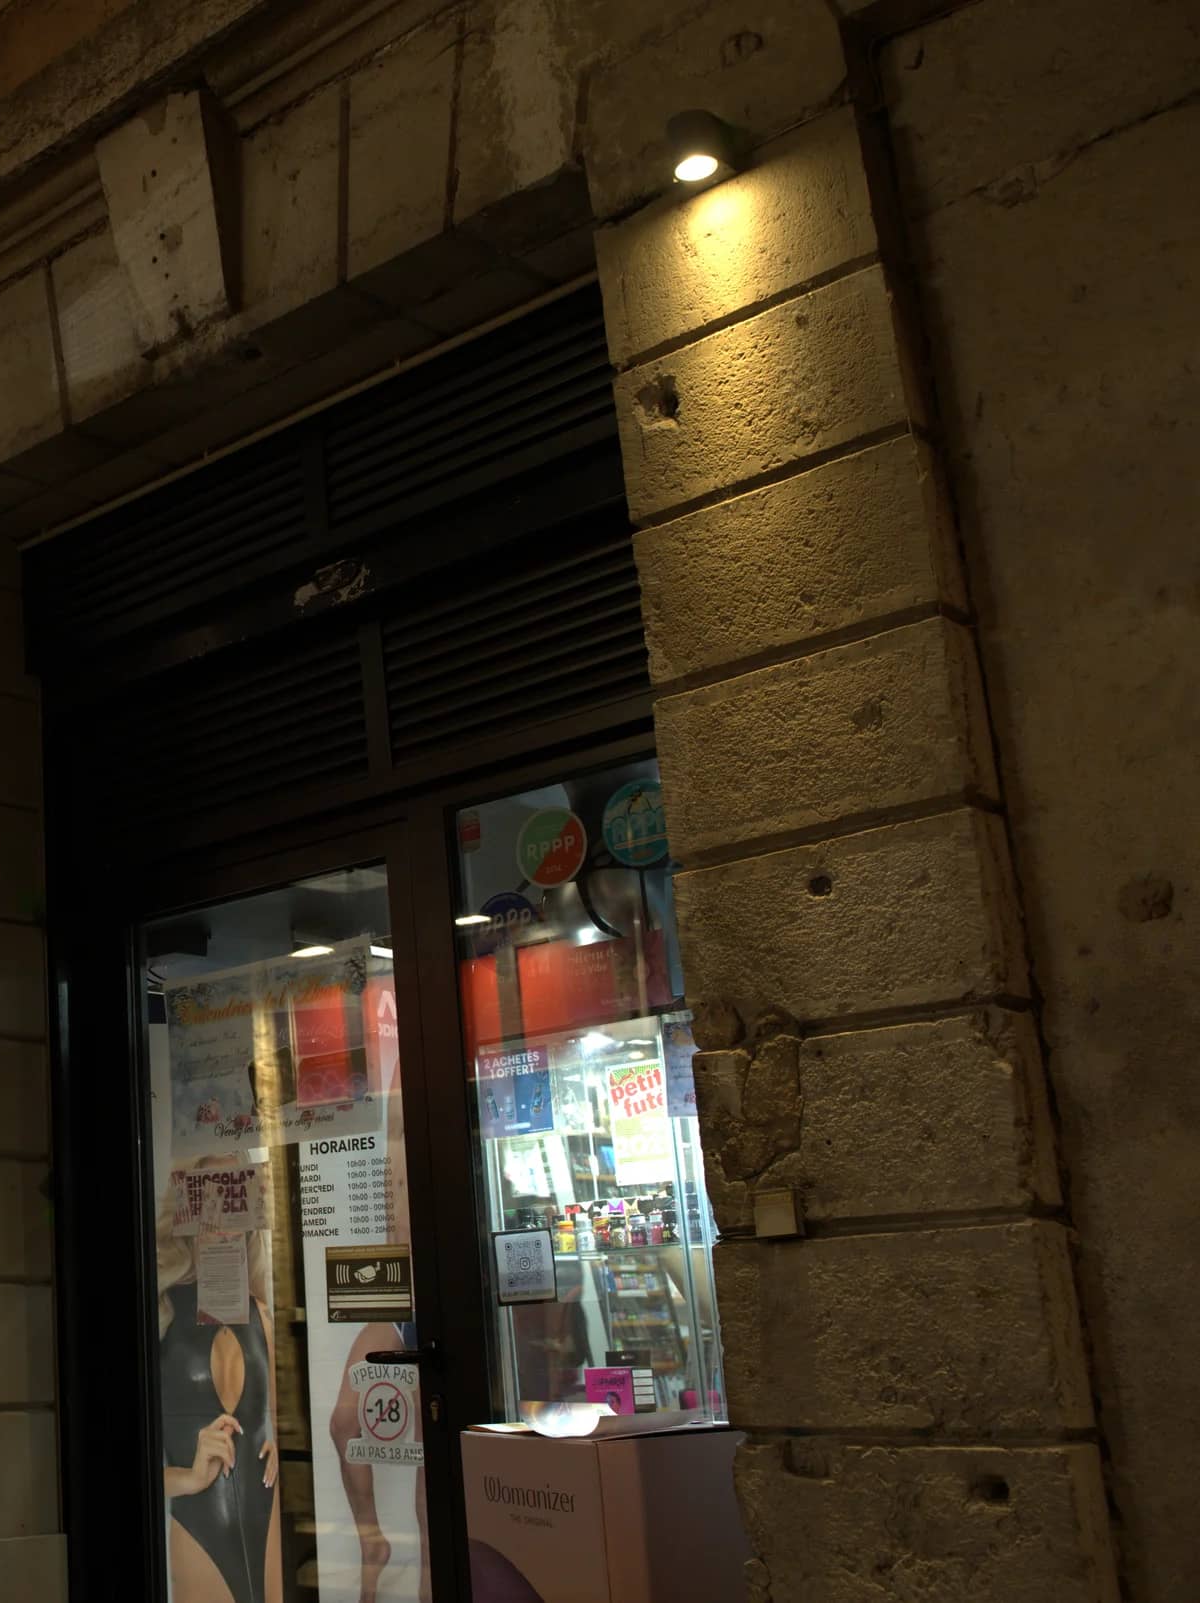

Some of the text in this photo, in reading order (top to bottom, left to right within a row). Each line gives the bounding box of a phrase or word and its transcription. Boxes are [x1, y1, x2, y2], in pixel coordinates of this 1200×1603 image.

[527, 834, 576, 861] RPPP
[484, 1058, 491, 1069] 2
[492, 1049, 540, 1068] ACHETÉS
[610, 1069, 662, 1106] petit
[310, 1136, 376, 1156] HORAIRES
[352, 1365, 415, 1385] J'PEUX PAS
[366, 1398, 401, 1423] -18
[349, 1446, 368, 1459] J'AI
[369, 1446, 388, 1459] PAS
[390, 1447, 402, 1460] 18
[483, 1475, 576, 1513] Womanizer
